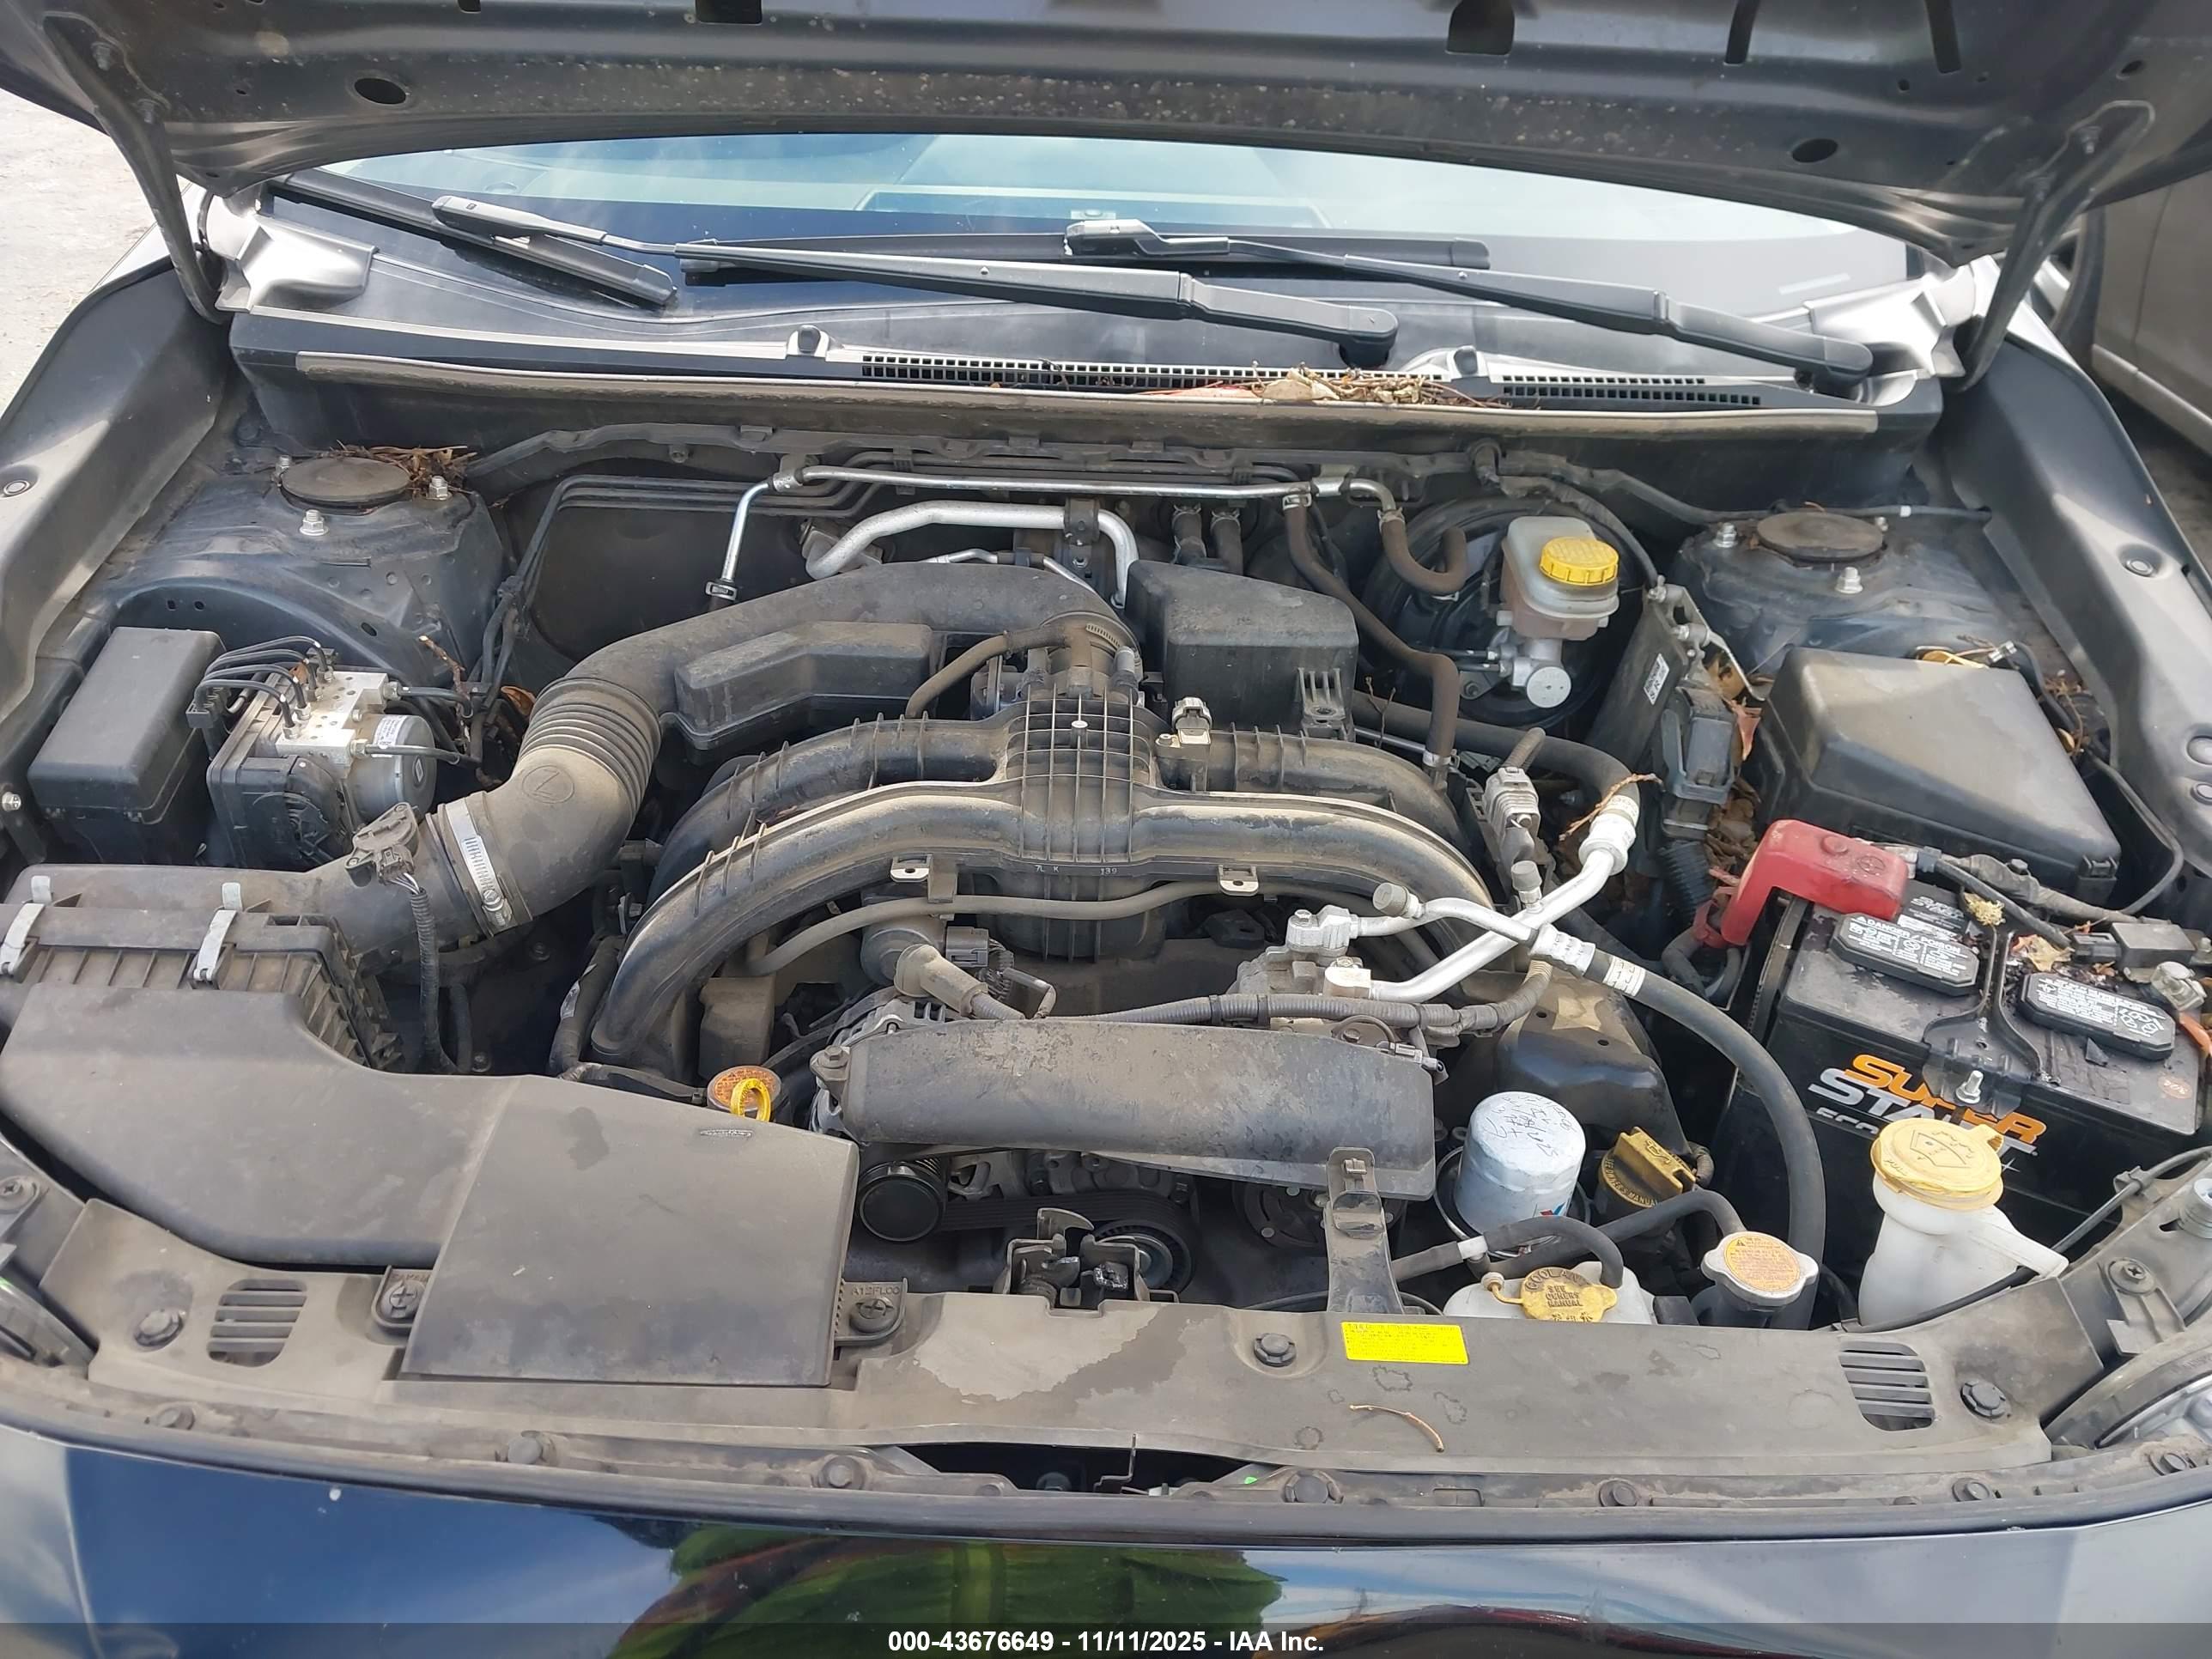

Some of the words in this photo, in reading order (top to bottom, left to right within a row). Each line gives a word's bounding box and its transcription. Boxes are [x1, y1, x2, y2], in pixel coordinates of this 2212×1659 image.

[1866, 918, 1911, 939] DANGER
[1920, 935, 1961, 954] POISON
[1808, 1067, 2039, 1158] STAT
[1524, 1267, 1590, 1291] COOLAN
[1547, 1299, 1583, 1308] MANUAL
